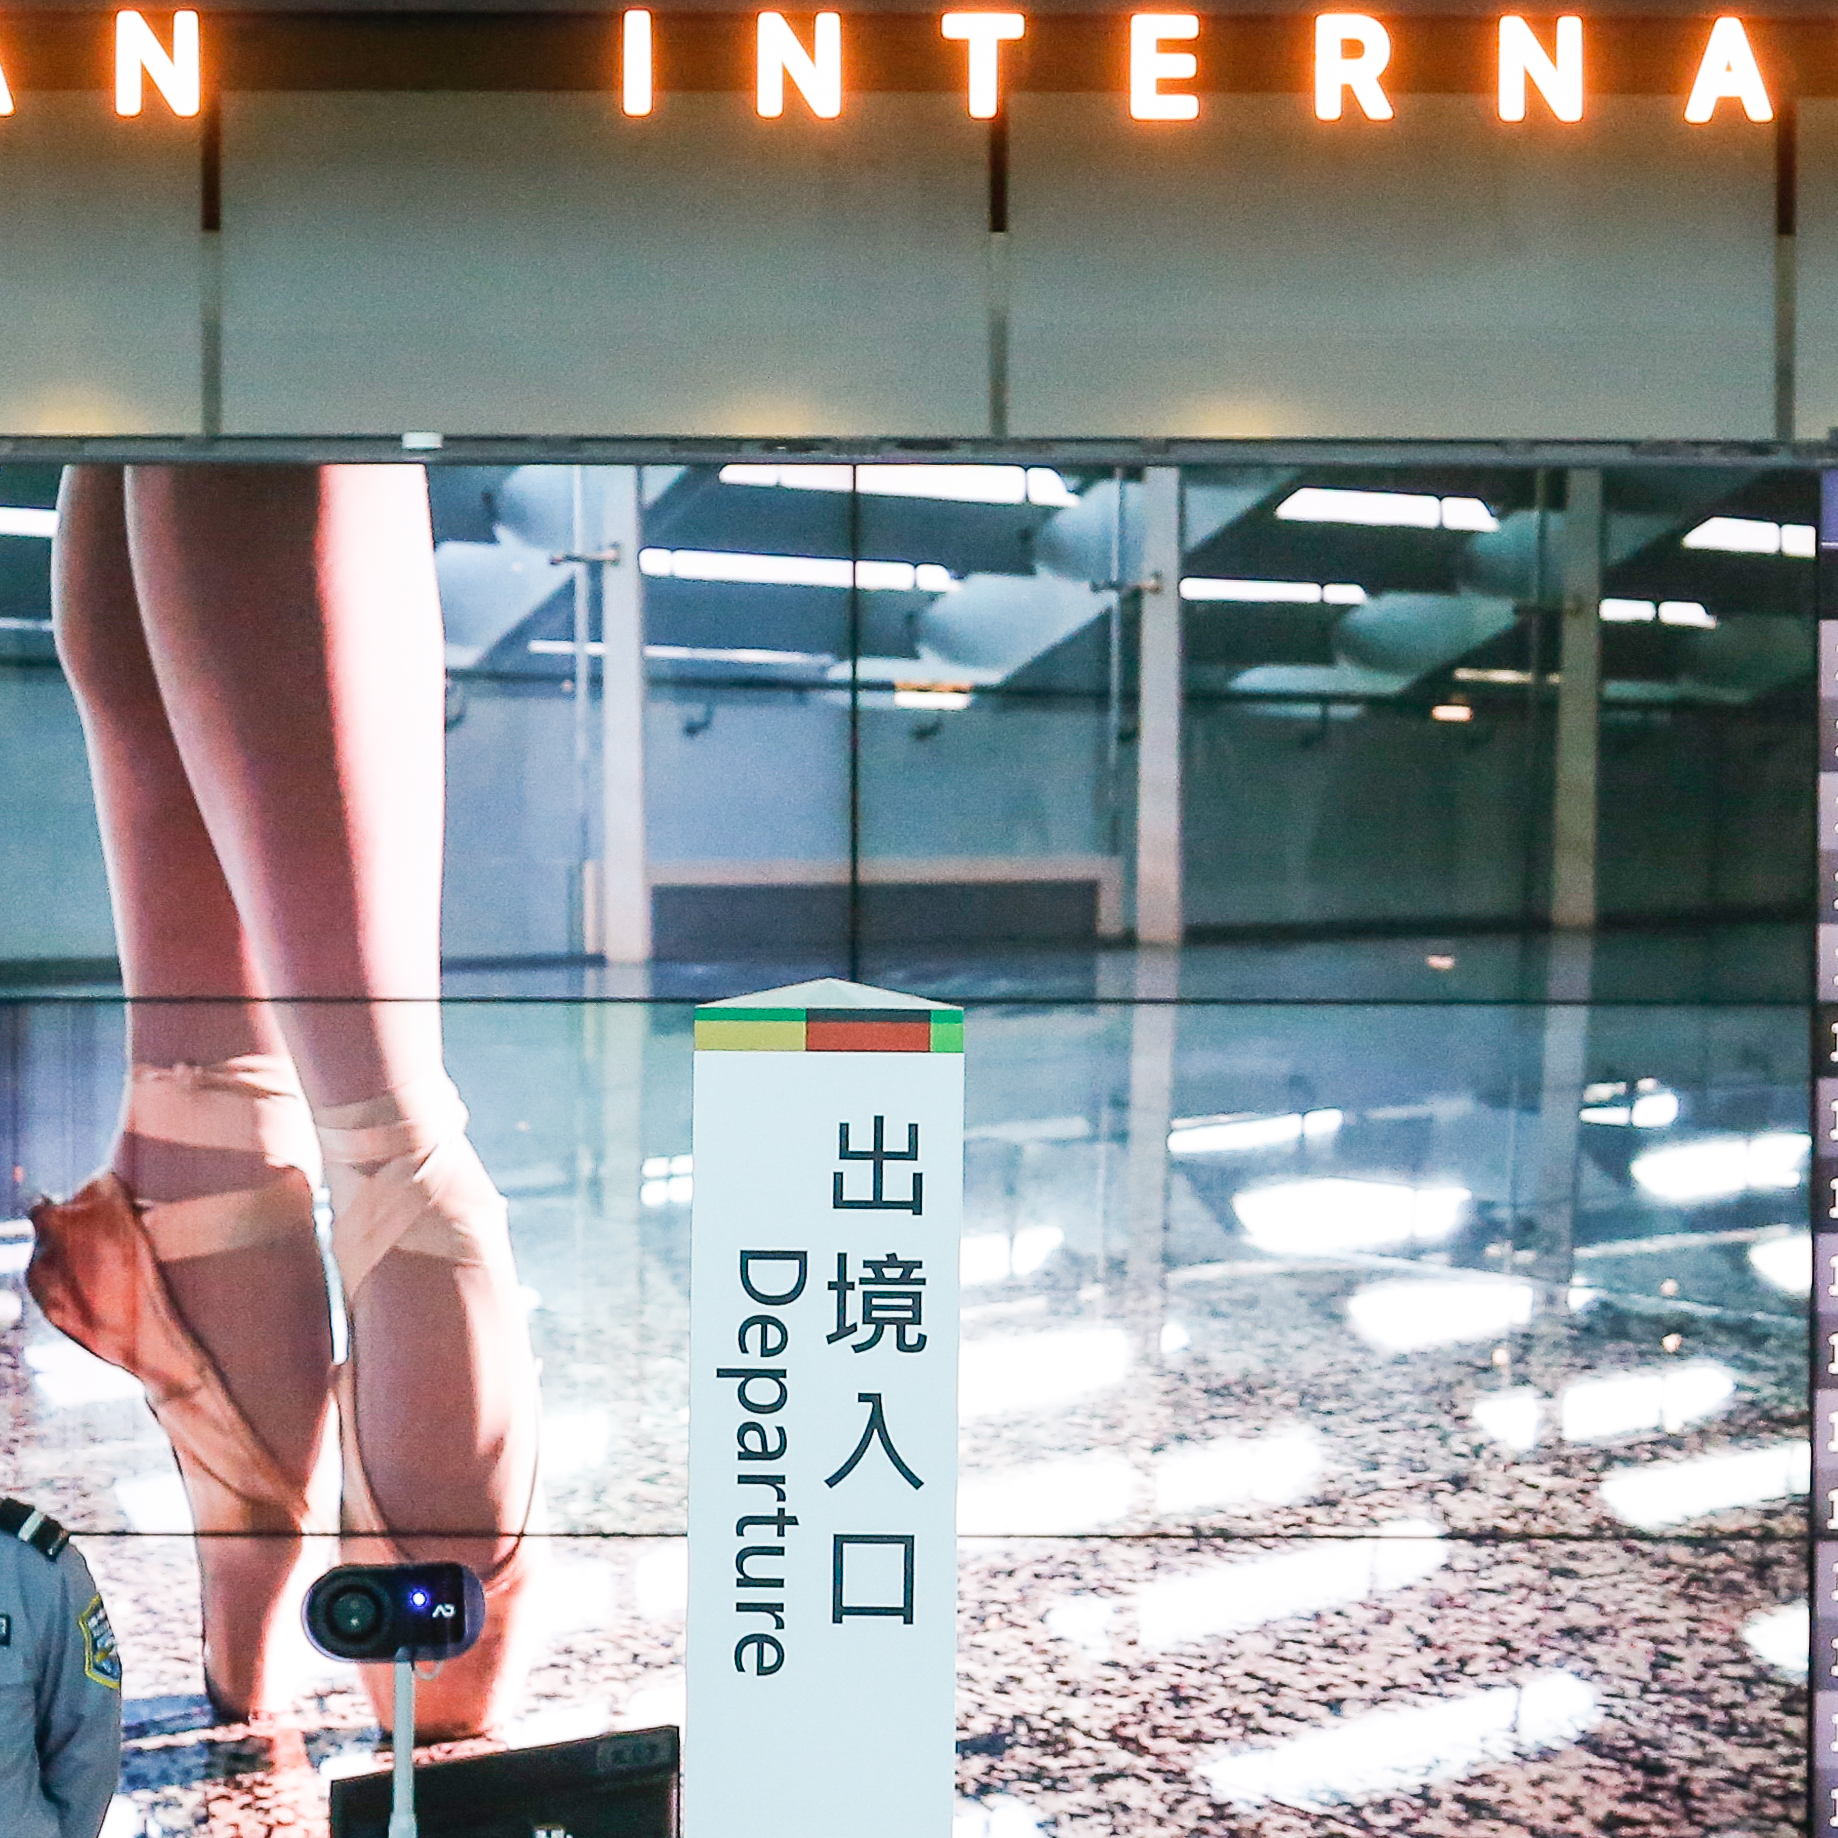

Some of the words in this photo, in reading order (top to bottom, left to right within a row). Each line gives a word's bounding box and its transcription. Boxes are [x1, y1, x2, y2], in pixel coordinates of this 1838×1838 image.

[715, 1250, 809, 1677] Departure
[825, 1115, 928, 1624] 出境入口
